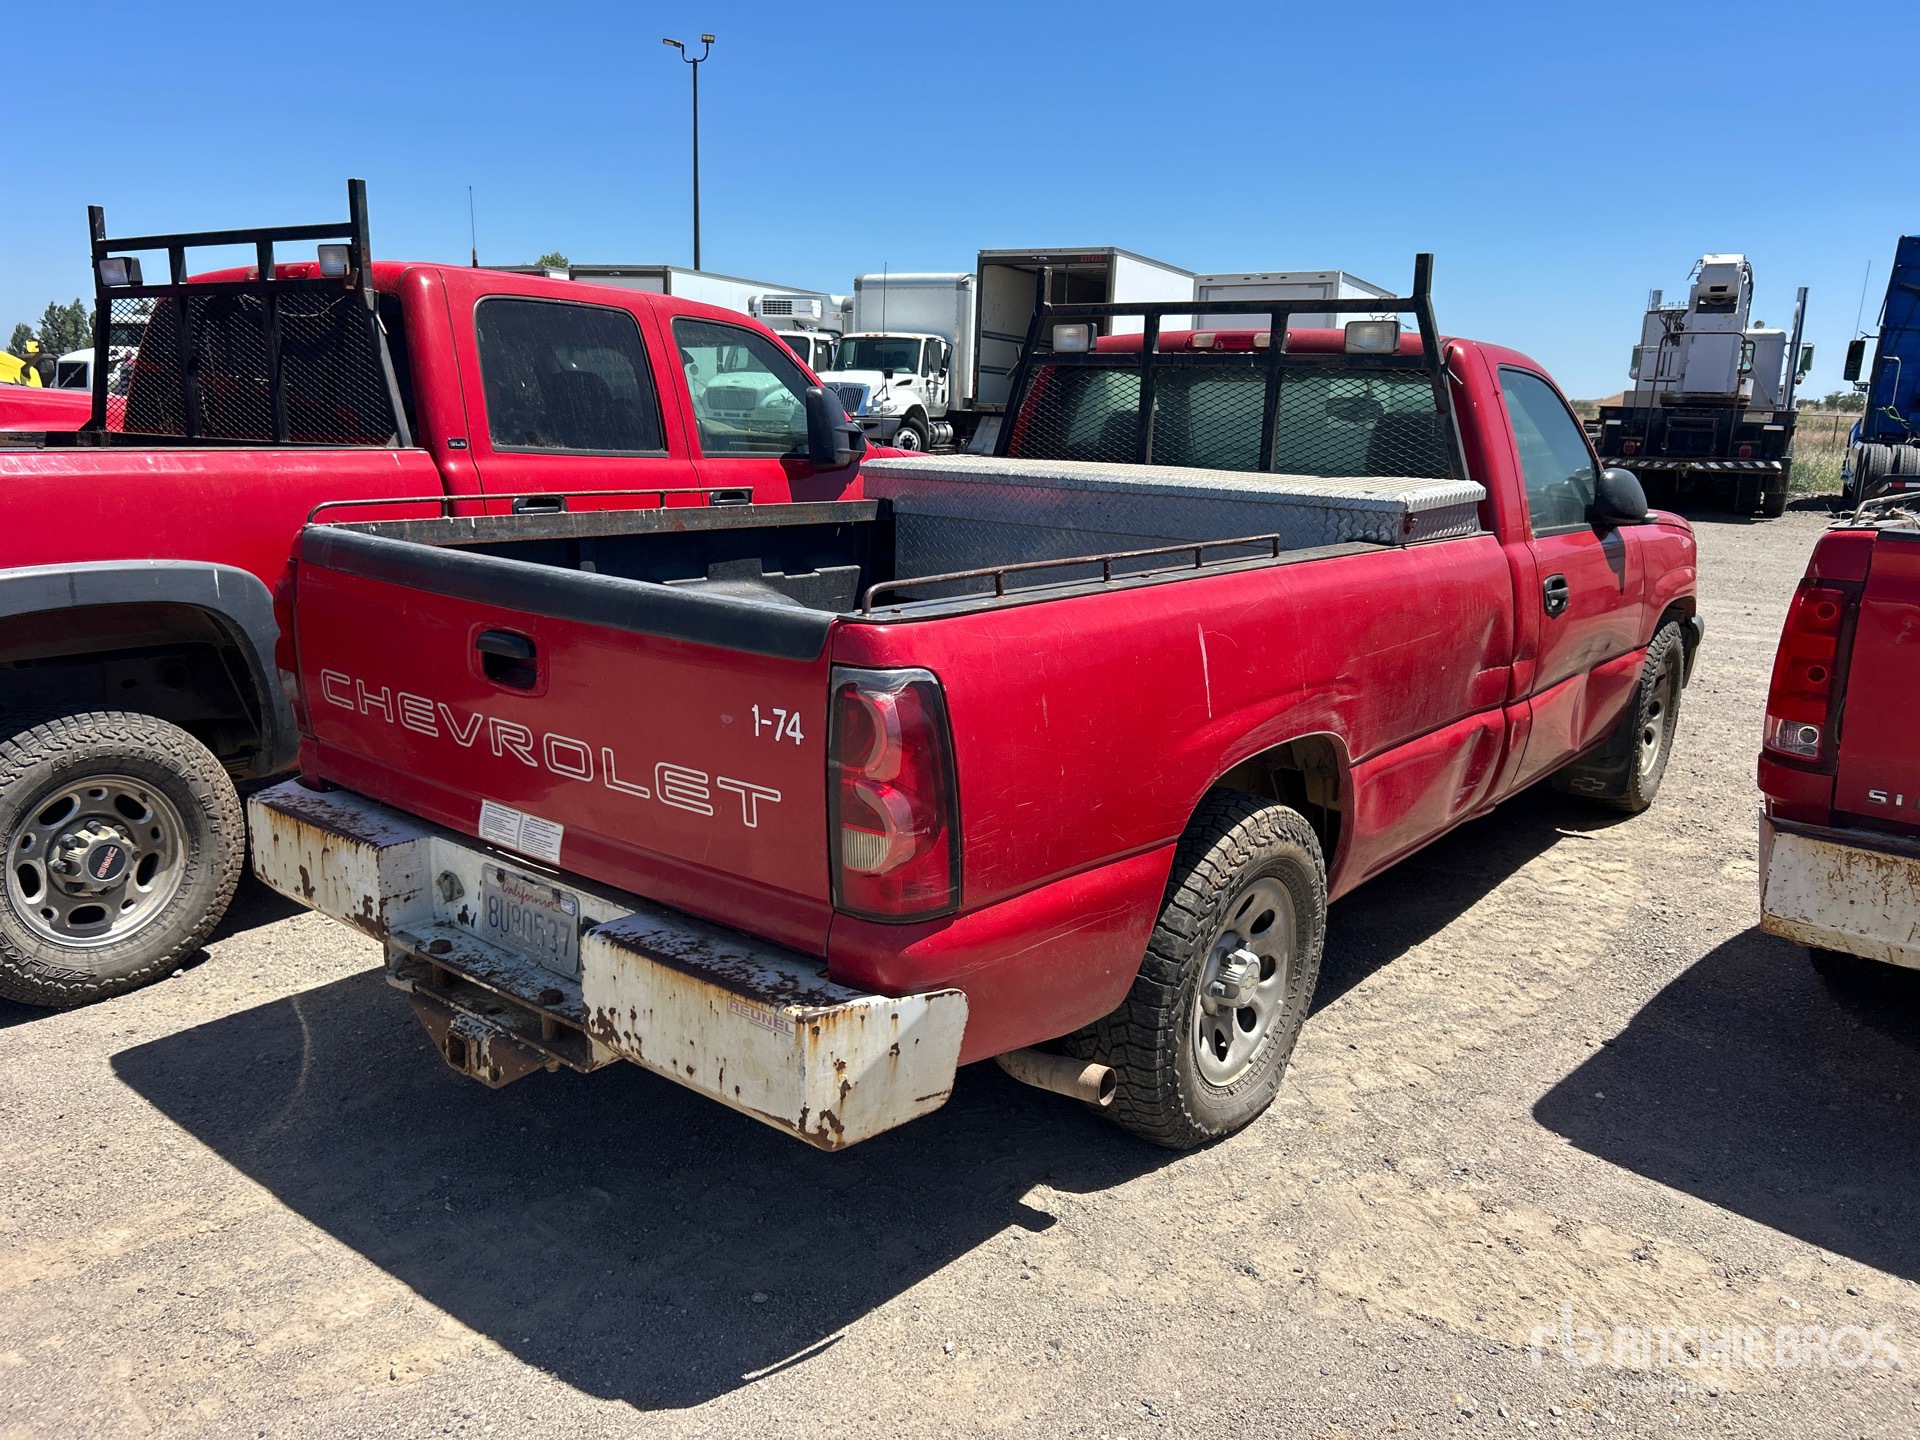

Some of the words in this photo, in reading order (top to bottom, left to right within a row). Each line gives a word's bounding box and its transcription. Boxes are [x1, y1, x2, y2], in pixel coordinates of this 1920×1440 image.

[751, 703, 805, 745] 1-74
[321, 667, 782, 828] CHEVROLET
[97, 846, 118, 878] GMC
[729, 999, 795, 1036] REUNEL
